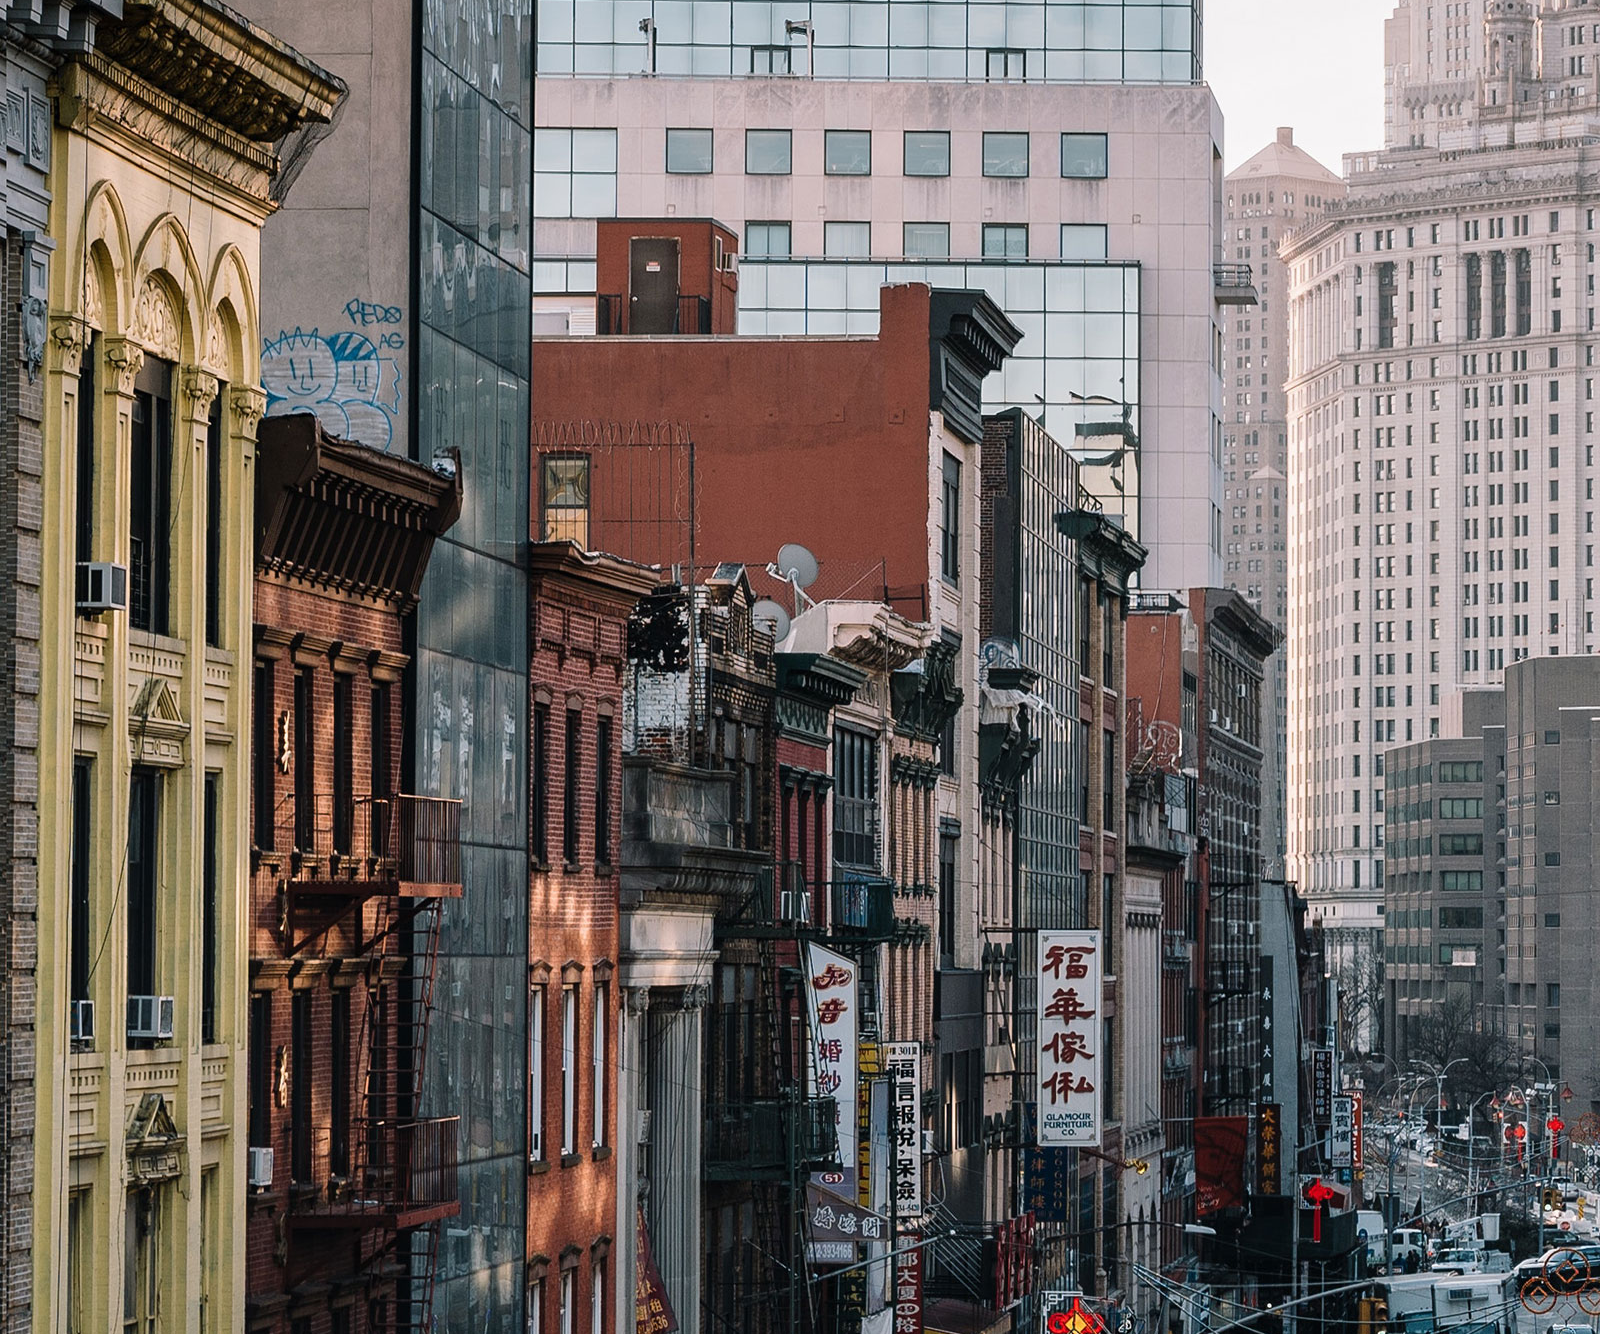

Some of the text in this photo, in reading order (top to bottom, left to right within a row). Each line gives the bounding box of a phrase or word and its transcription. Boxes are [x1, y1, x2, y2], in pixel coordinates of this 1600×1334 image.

[1046, 1113, 1092, 1121] GLAMOUR
[1043, 1121, 1094, 1129] FURNITURE
[823, 1172, 841, 1183] 51
